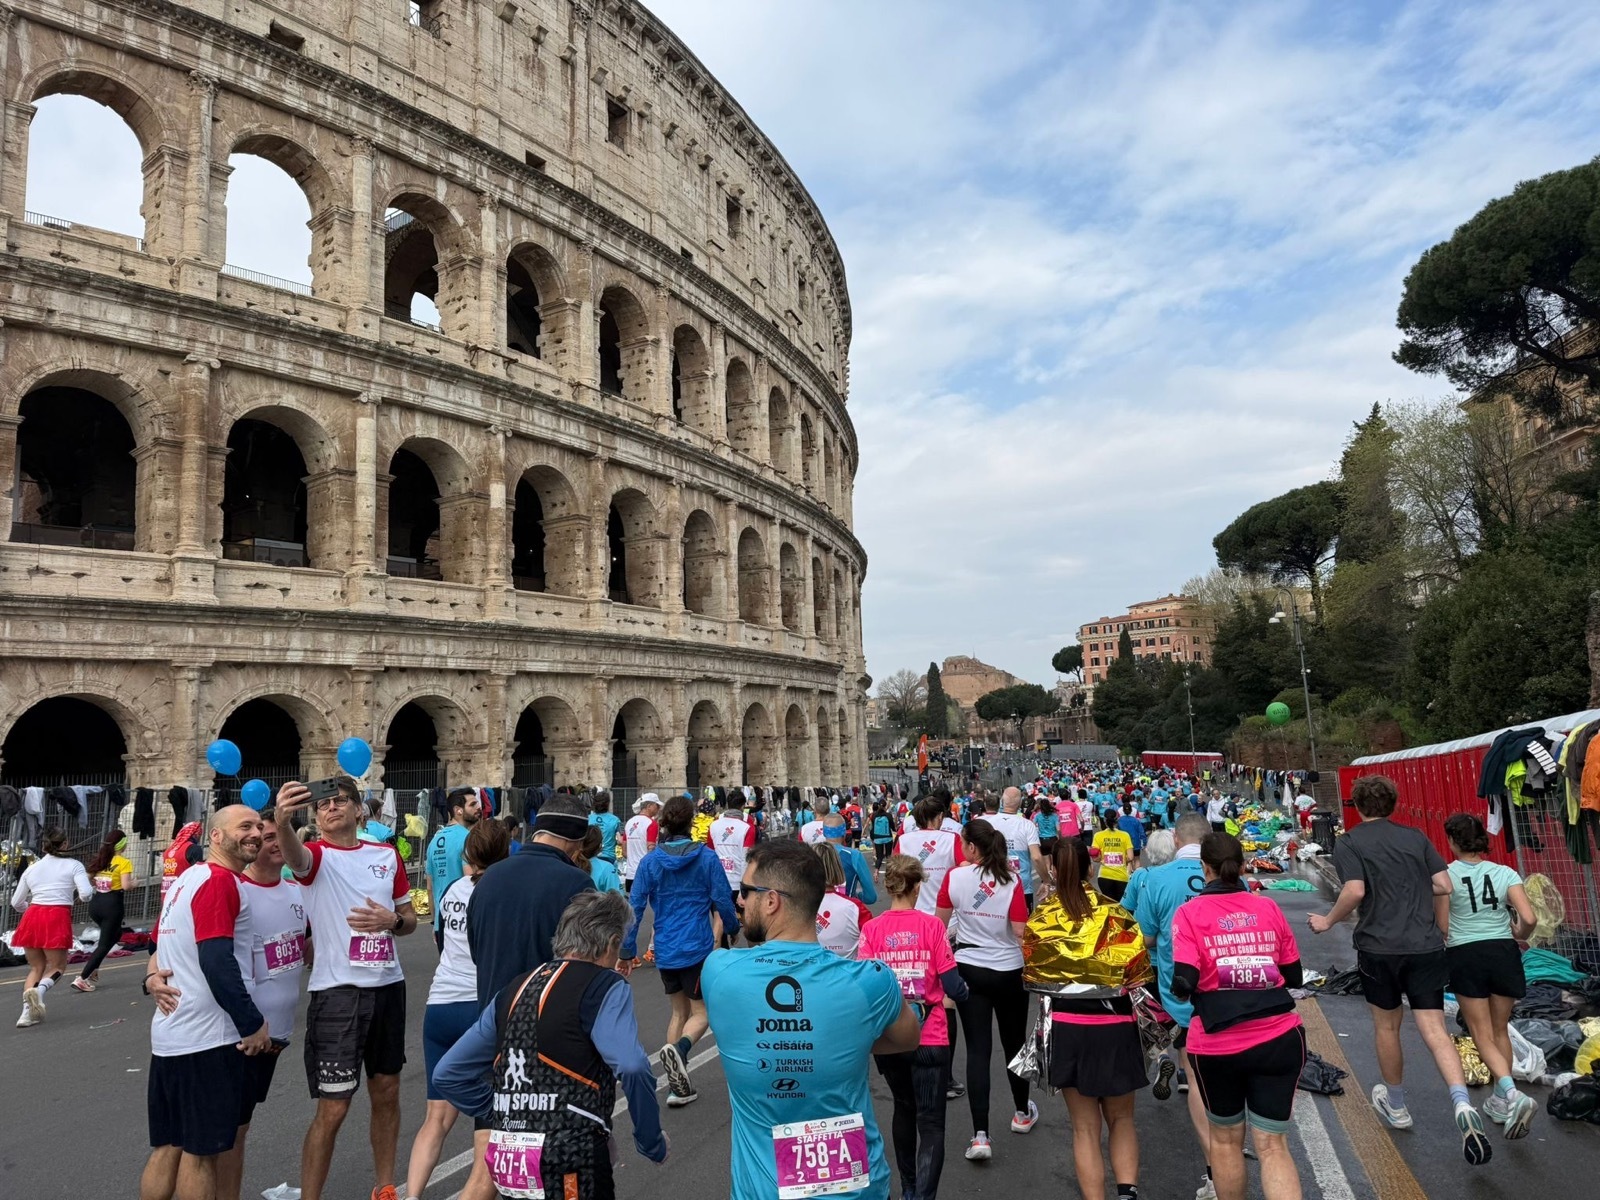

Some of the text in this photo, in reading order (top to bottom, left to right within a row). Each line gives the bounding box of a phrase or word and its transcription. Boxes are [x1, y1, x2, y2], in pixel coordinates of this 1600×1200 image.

[978, 881, 995, 898] SPORT
[1461, 874, 1499, 913] 14
[1212, 931, 1256, 946] TRAPIANTO
[275, 939, 300, 959] 803-A
[360, 940, 389, 954] 805-A
[1229, 968, 1267, 983] 138-A
[775, 1058, 814, 1066] TURKISH
[512, 1093, 558, 1111] SPORT
[502, 1116, 527, 1131] Roma
[797, 1130, 844, 1145] STAFFETTA
[497, 1144, 526, 1153] STAFFETTA
[791, 1138, 852, 1170] 758-A
[493, 1151, 528, 1176] 267-A
[796, 1171, 806, 1183] 2
